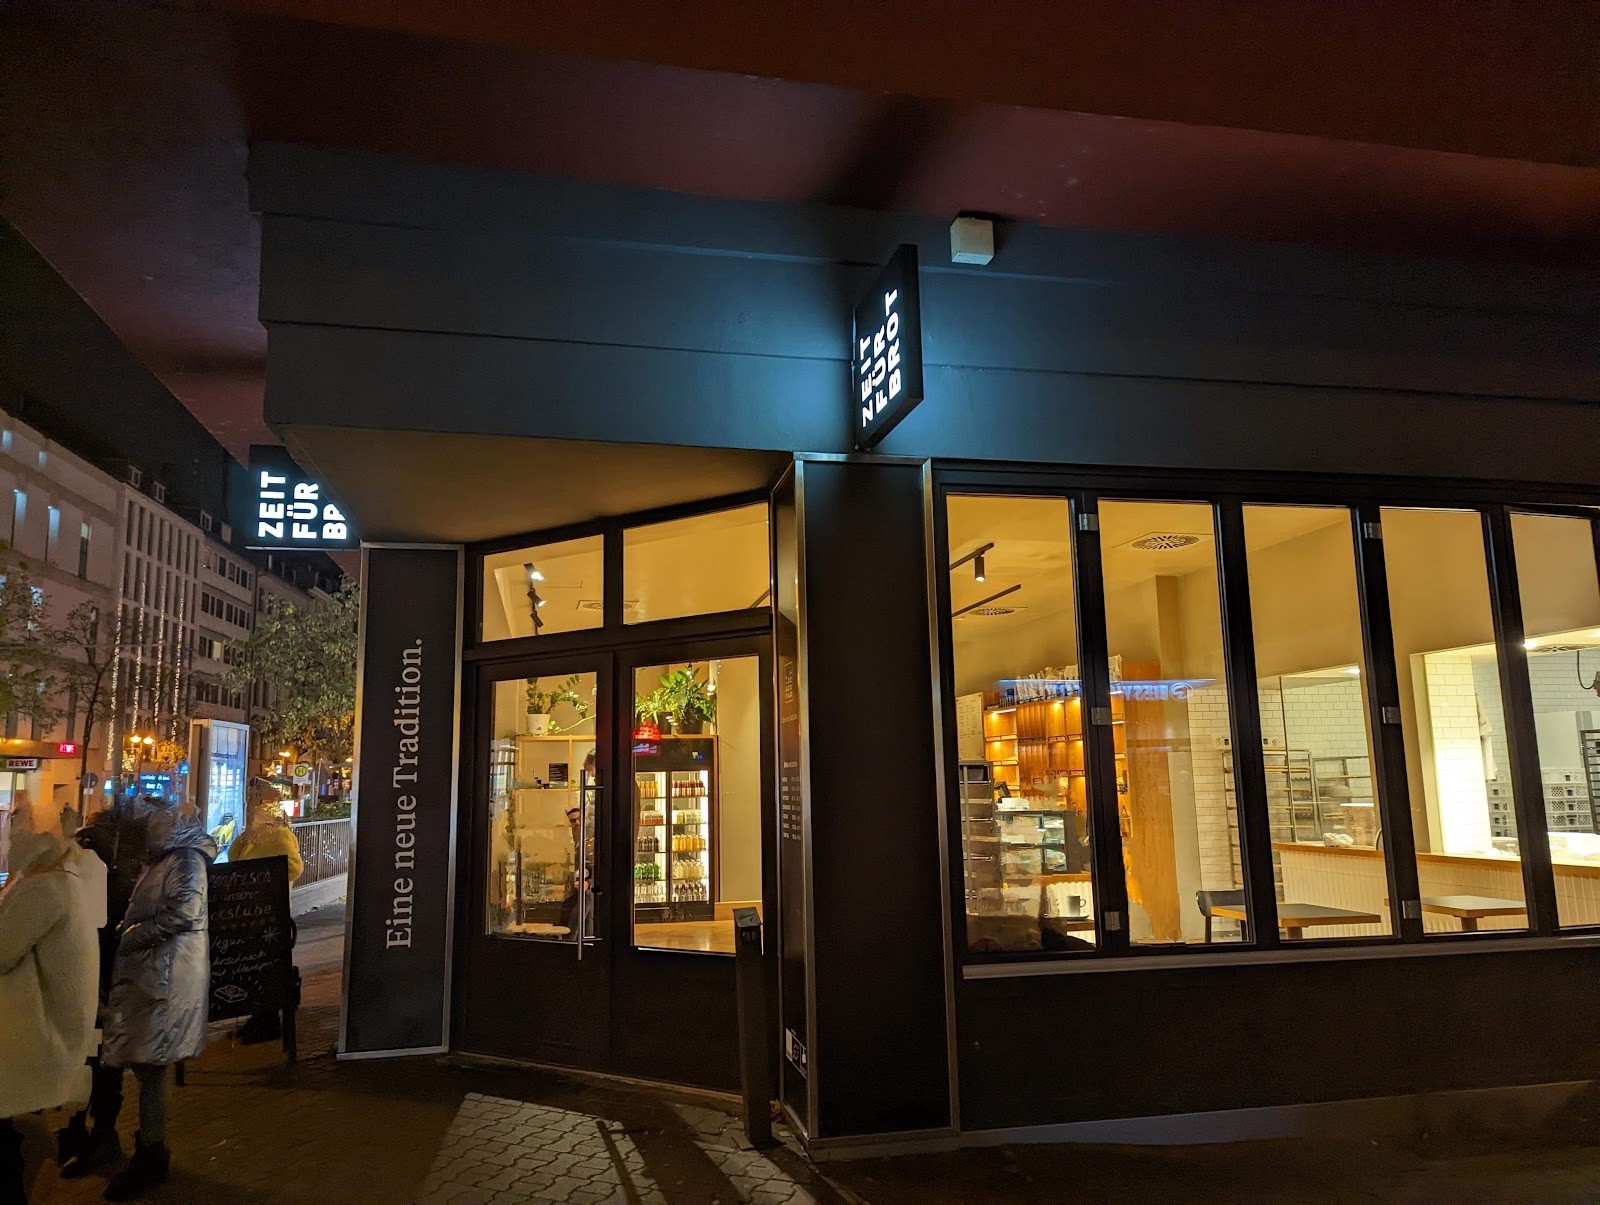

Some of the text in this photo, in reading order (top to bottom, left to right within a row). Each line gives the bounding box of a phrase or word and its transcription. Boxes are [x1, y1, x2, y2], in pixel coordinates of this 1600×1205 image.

[860, 336, 873, 427] ZEIT
[872, 325, 887, 414] FÜR
[885, 289, 901, 400] BROT
[258, 471, 286, 538] ZEIT
[286, 482, 319, 539] FÜR
[322, 503, 347, 540] BR
[8, 759, 34, 767] REWE
[385, 638, 422, 950] Eine neue Tradition.
